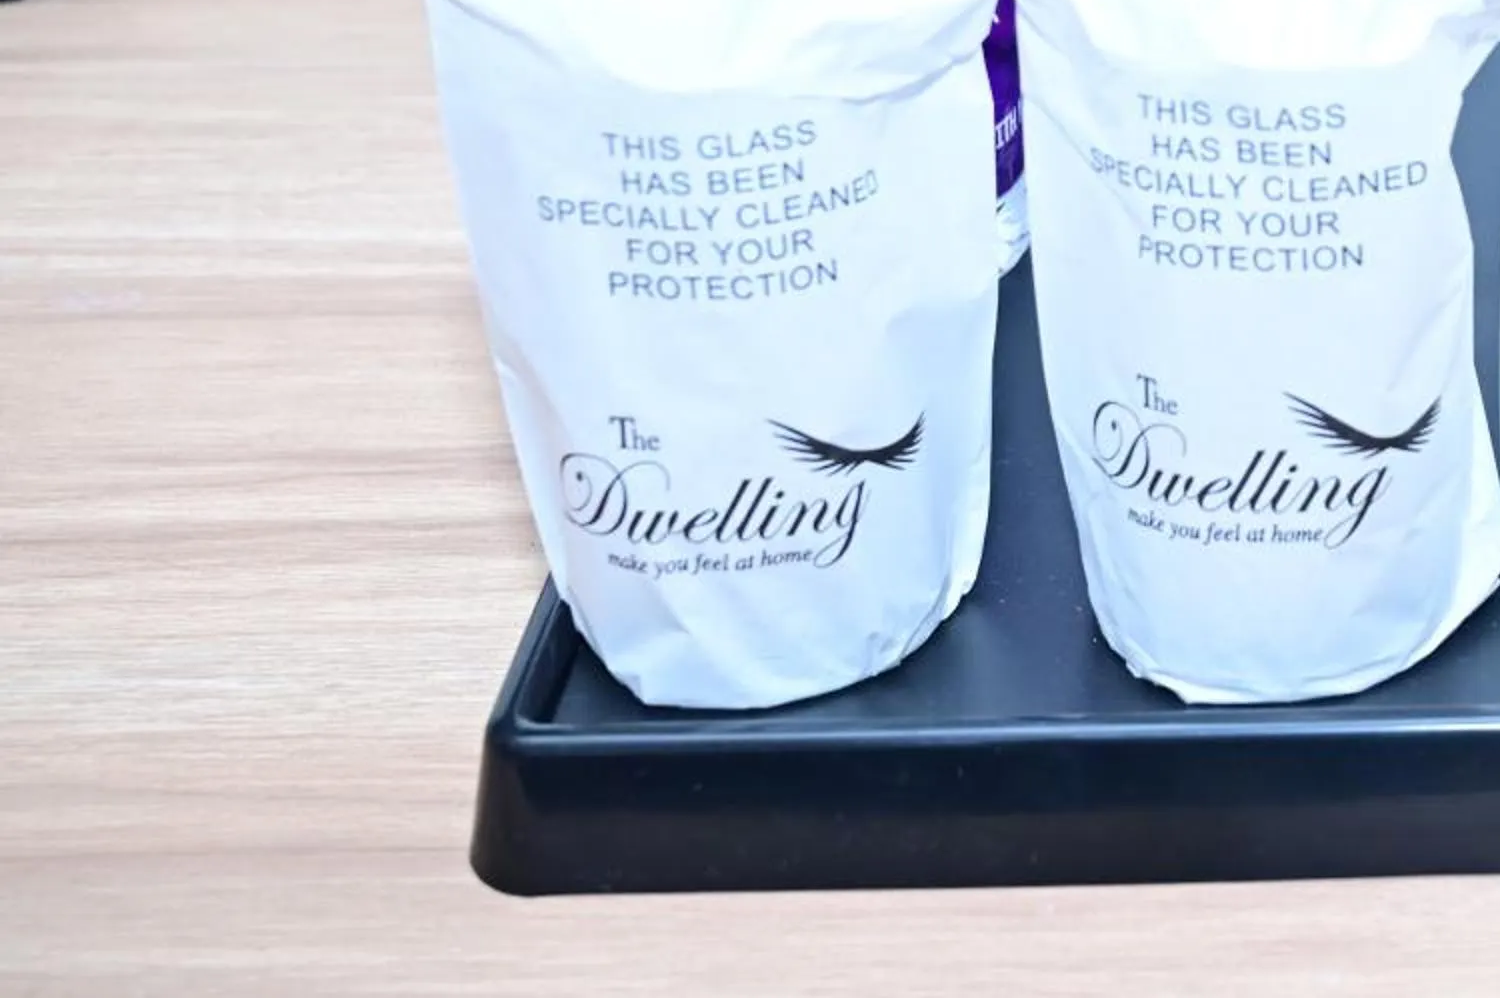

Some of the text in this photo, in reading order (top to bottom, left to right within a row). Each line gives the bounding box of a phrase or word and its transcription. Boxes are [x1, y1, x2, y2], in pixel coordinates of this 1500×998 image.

[1137, 92, 1347, 132] THIS GLASS
[601, 120, 818, 162] THIS GLASS
[1151, 134, 1332, 167] HAS BEEN
[620, 158, 805, 197] HAS BEEN
[1089, 146, 1428, 203] SPECIALLY CLEANED
[536, 169, 880, 231] SPECIALLY CLEANED
[1151, 205, 1340, 238] FOR YOUR
[626, 228, 814, 266] FOR YOUR
[1138, 234, 1364, 272] PROTECTION
[608, 258, 838, 301] PROTECTION
[1136, 373, 1178, 415] The
[609, 415, 662, 452] The
[1092, 399, 1394, 550] Dwelling
[560, 452, 871, 569] Dwelling
[1127, 507, 1324, 546] make you feel at home
[607, 548, 814, 580] make you feel at home
